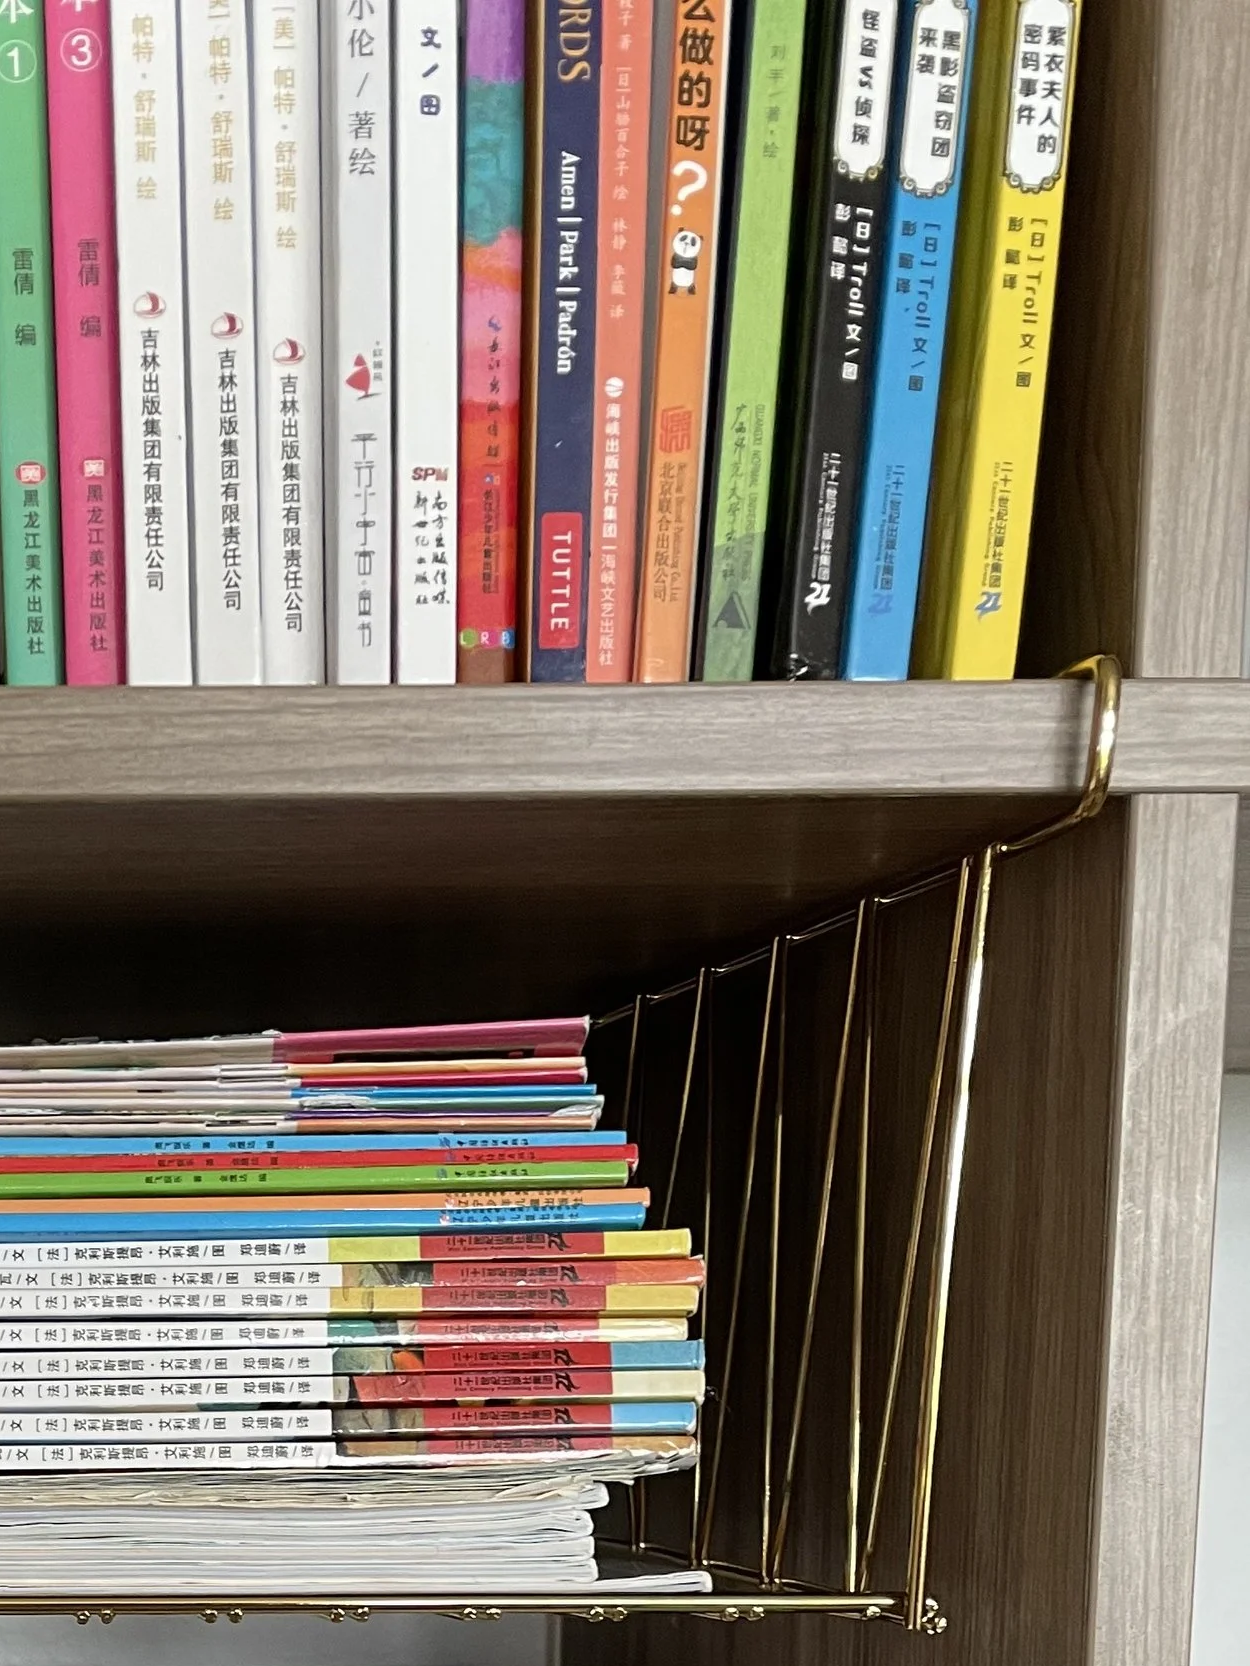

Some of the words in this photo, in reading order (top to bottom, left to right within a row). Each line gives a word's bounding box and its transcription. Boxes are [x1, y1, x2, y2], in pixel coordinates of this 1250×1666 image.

[558, 0, 593, 83] RDS
[916, 26, 940, 76] 来袭
[930, 30, 962, 158] 黑影盗窃团
[1016, 23, 1044, 126] 密码事件
[1036, 26, 1068, 155] 紫衣夫人的
[136, 177, 158, 201] 绘
[214, 197, 235, 221] 绘
[560, 150, 582, 211] Amen
[276, 226, 298, 250] 绘
[558, 230, 579, 281] Park
[556, 300, 580, 376] Padrón
[140, 327, 165, 592] 吉林出版集团有限责任公司
[217, 348, 243, 611] 吉林出版集团有限责任公司
[279, 373, 304, 633] 吉林出版集团有限责任公司
[603, 403, 622, 539] 海峡出版发行集团
[23, 489, 46, 656] 黑龙江美术出版社
[87, 484, 110, 653] 黑龙江美术出版社
[549, 530, 573, 631] TUTTLE
[653, 462, 676, 603] 北京联合出版公司
[599, 554, 620, 667] 海峡文艺出版社
